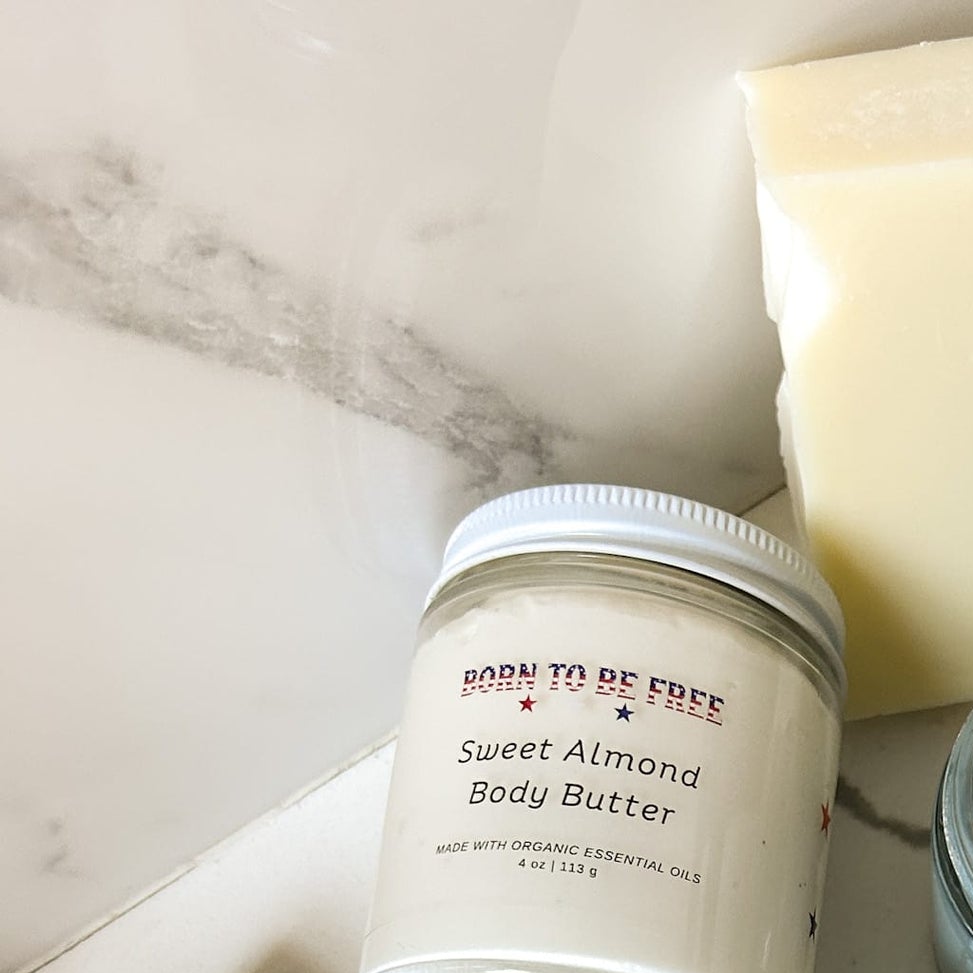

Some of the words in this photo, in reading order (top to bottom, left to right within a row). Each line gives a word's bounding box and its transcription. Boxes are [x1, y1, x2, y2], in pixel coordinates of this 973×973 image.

[460, 663, 537, 697] BORN
[548, 663, 586, 692] TO
[595, 667, 638, 700] BE
[646, 676, 724, 726] FREE
[457, 738, 553, 764] Sweet
[562, 739, 701, 789] Almond
[469, 780, 548, 809] Body
[561, 783, 676, 825] Butter
[435, 841, 469, 854] MADE
[473, 840, 507, 851] WITH
[511, 840, 580, 855] ORGANIC
[583, 847, 665, 873] ESSENTIAL
[670, 866, 702, 884] OILS
[518, 858, 526, 868] 4
[531, 861, 545, 870] oz
[560, 861, 584, 874] 113
[589, 867, 598, 878] g
